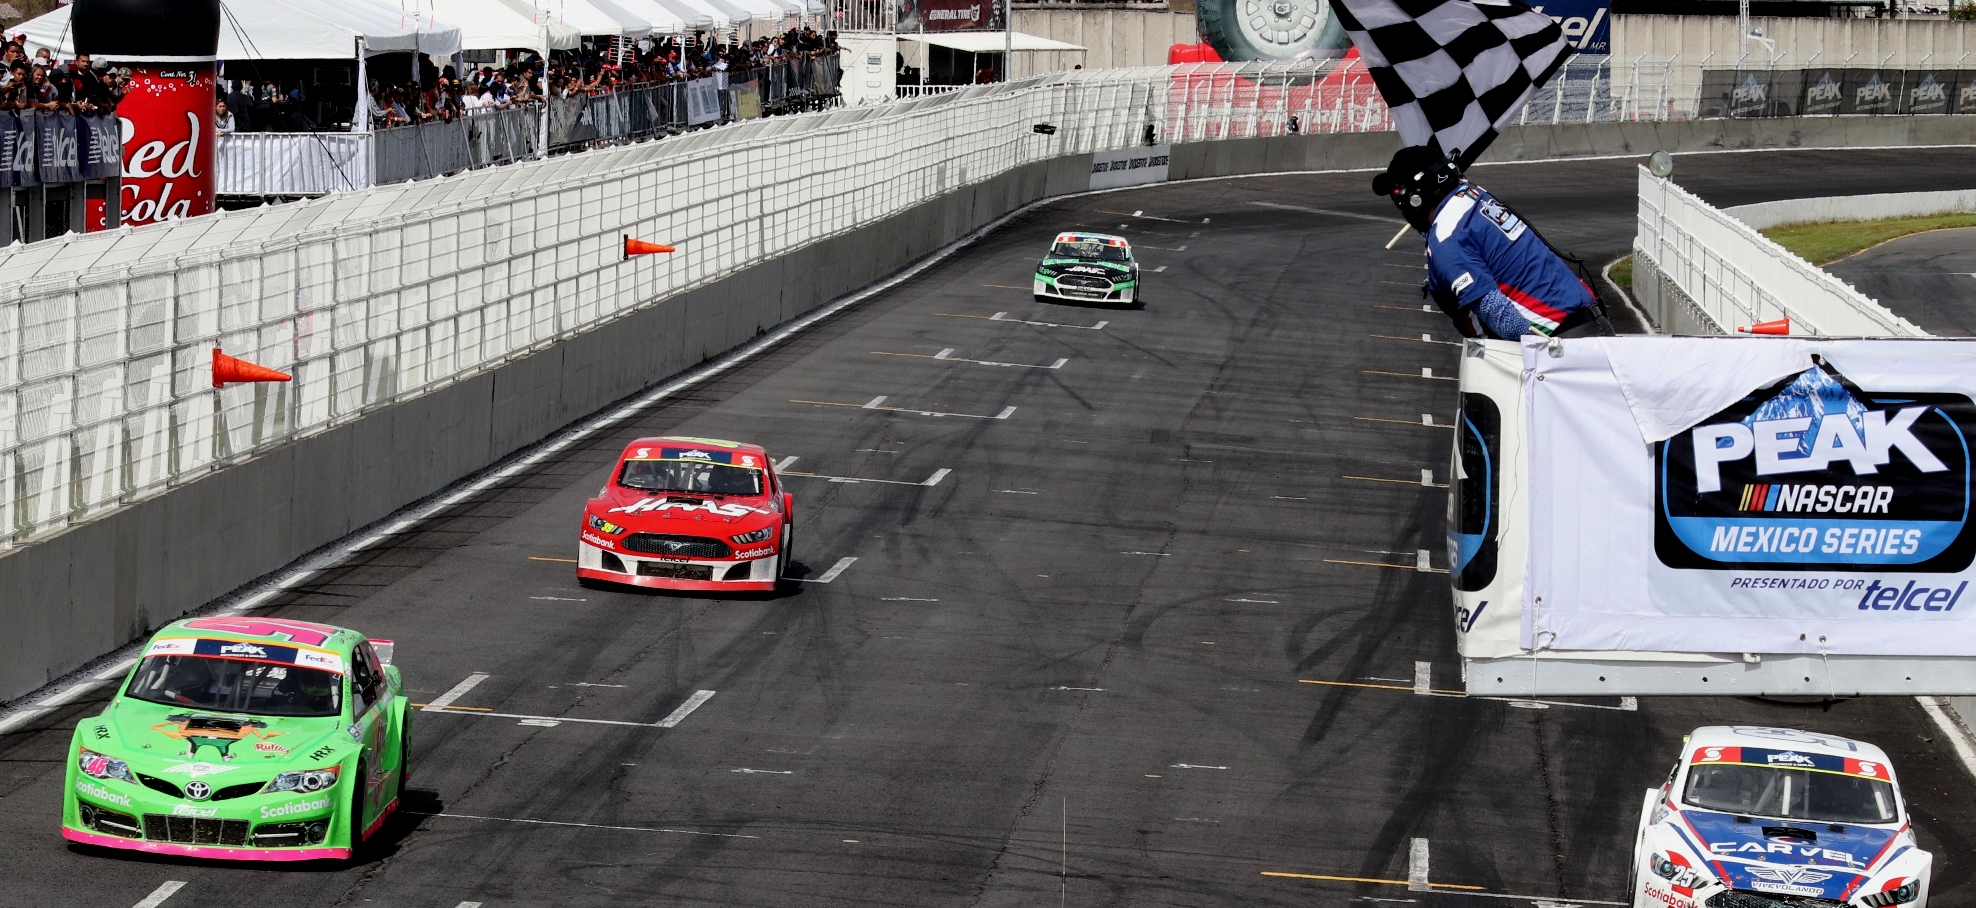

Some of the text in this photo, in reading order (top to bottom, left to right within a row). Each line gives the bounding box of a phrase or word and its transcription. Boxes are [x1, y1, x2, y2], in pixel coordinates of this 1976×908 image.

[929, 9, 957, 20] GENERAL
[957, 9, 972, 20] TIRE
[1732, 84, 1767, 108] PEAK
[1807, 82, 1842, 106] PEAK
[1855, 82, 1892, 106] PEAK
[1909, 82, 1946, 106] PEAK
[1960, 86, 1976, 106] PE
[1692, 404, 1950, 494] PEAK
[608, 497, 771, 518] HAAS
[1776, 484, 1894, 514] NASCAR
[582, 530, 615, 550] Scotiabank
[1710, 526, 1922, 555] MEXICO SERIES
[735, 546, 775, 559] Scotiabank
[1731, 577, 1865, 591] PRESENTADO POR
[1858, 579, 1969, 612] telcel
[153, 643, 181, 651] FedEx
[220, 643, 267, 655] PEAK
[305, 654, 334, 665] FedEx
[309, 745, 335, 762] HRX
[1767, 752, 1815, 766] PEAK
[86, 758, 109, 775] 46
[76, 778, 133, 808] Scotiabank
[172, 804, 218, 817] telcel
[260, 795, 331, 819] Scotiabank
[1669, 865, 1695, 888] 25
